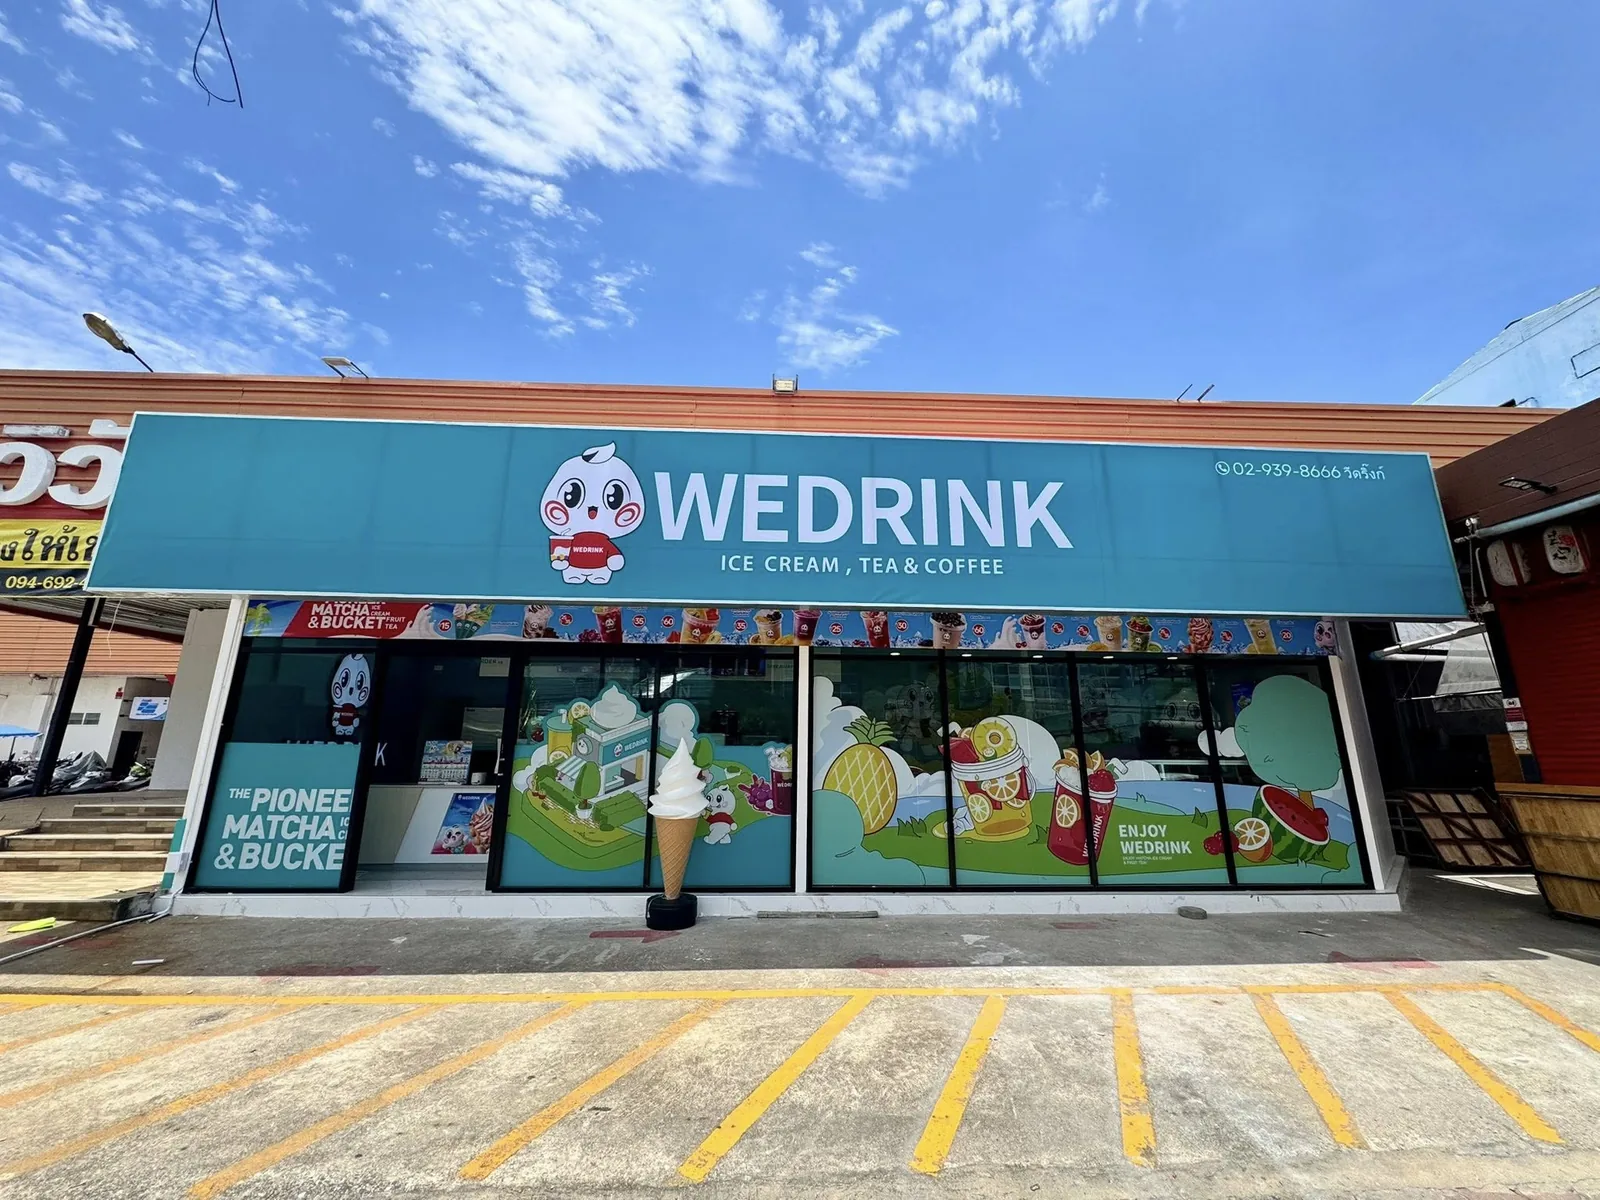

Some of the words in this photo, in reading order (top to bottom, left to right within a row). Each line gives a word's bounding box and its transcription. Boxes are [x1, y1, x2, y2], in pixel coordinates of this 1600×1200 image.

[1233, 462, 1341, 478] 02-939-8666
[654, 472, 1074, 549] WEDRINK
[721, 555, 754, 571] ICE
[859, 557, 898, 574] TEA
[903, 557, 919, 574] &
[924, 558, 1004, 575] COFFEE
[311, 603, 370, 617] MATCHA
[308, 617, 319, 629] &
[320, 616, 386, 630] BUCKET
[229, 788, 251, 798] THE
[250, 788, 354, 812] PIONEE
[222, 815, 336, 840] MATCHA
[1118, 824, 1167, 837] ENJOY
[213, 843, 236, 870] &
[238, 842, 346, 870] BUCKE
[1120, 841, 1193, 854] WEDRINK
